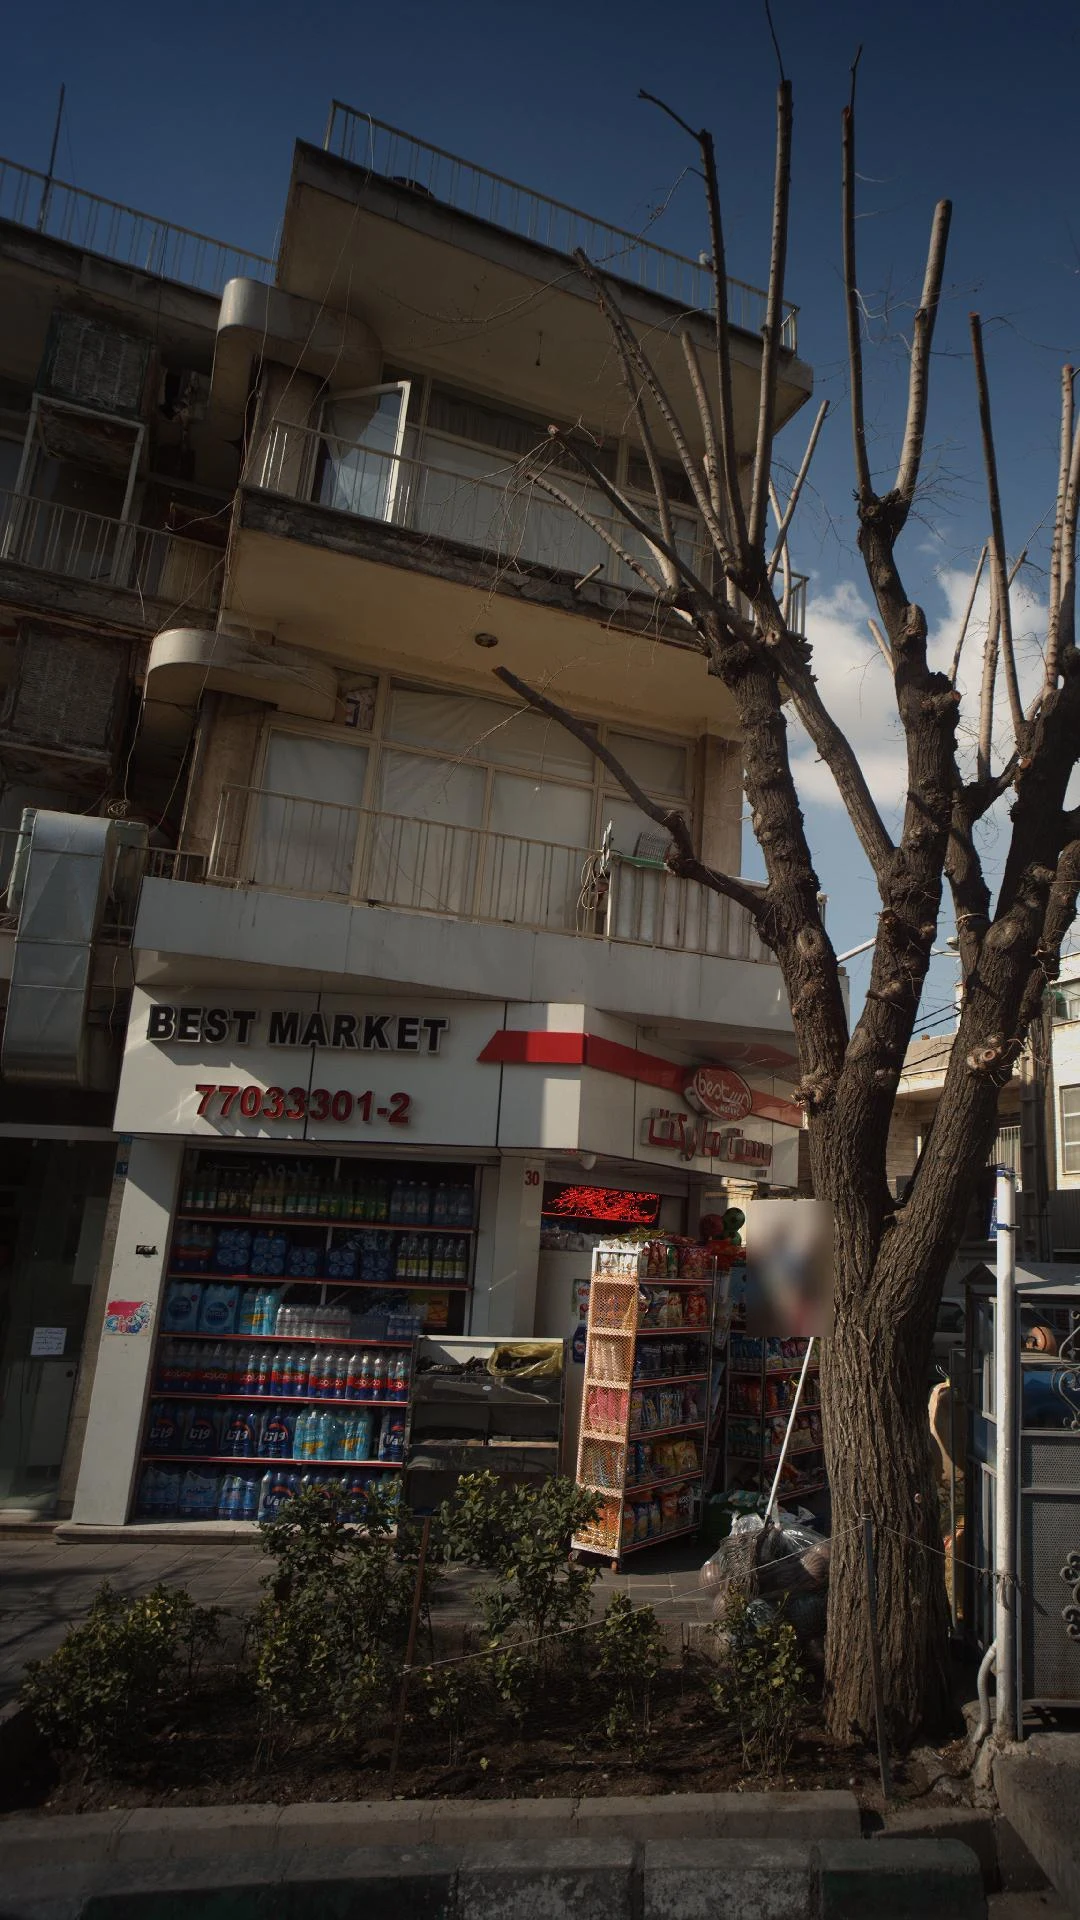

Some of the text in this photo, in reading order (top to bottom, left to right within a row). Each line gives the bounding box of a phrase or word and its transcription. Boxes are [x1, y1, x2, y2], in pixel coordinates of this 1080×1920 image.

[147, 1003, 449, 1054] BEST MARKET
[194, 1084, 413, 1124] 77033301-2
[524, 1170, 540, 1186] 30
